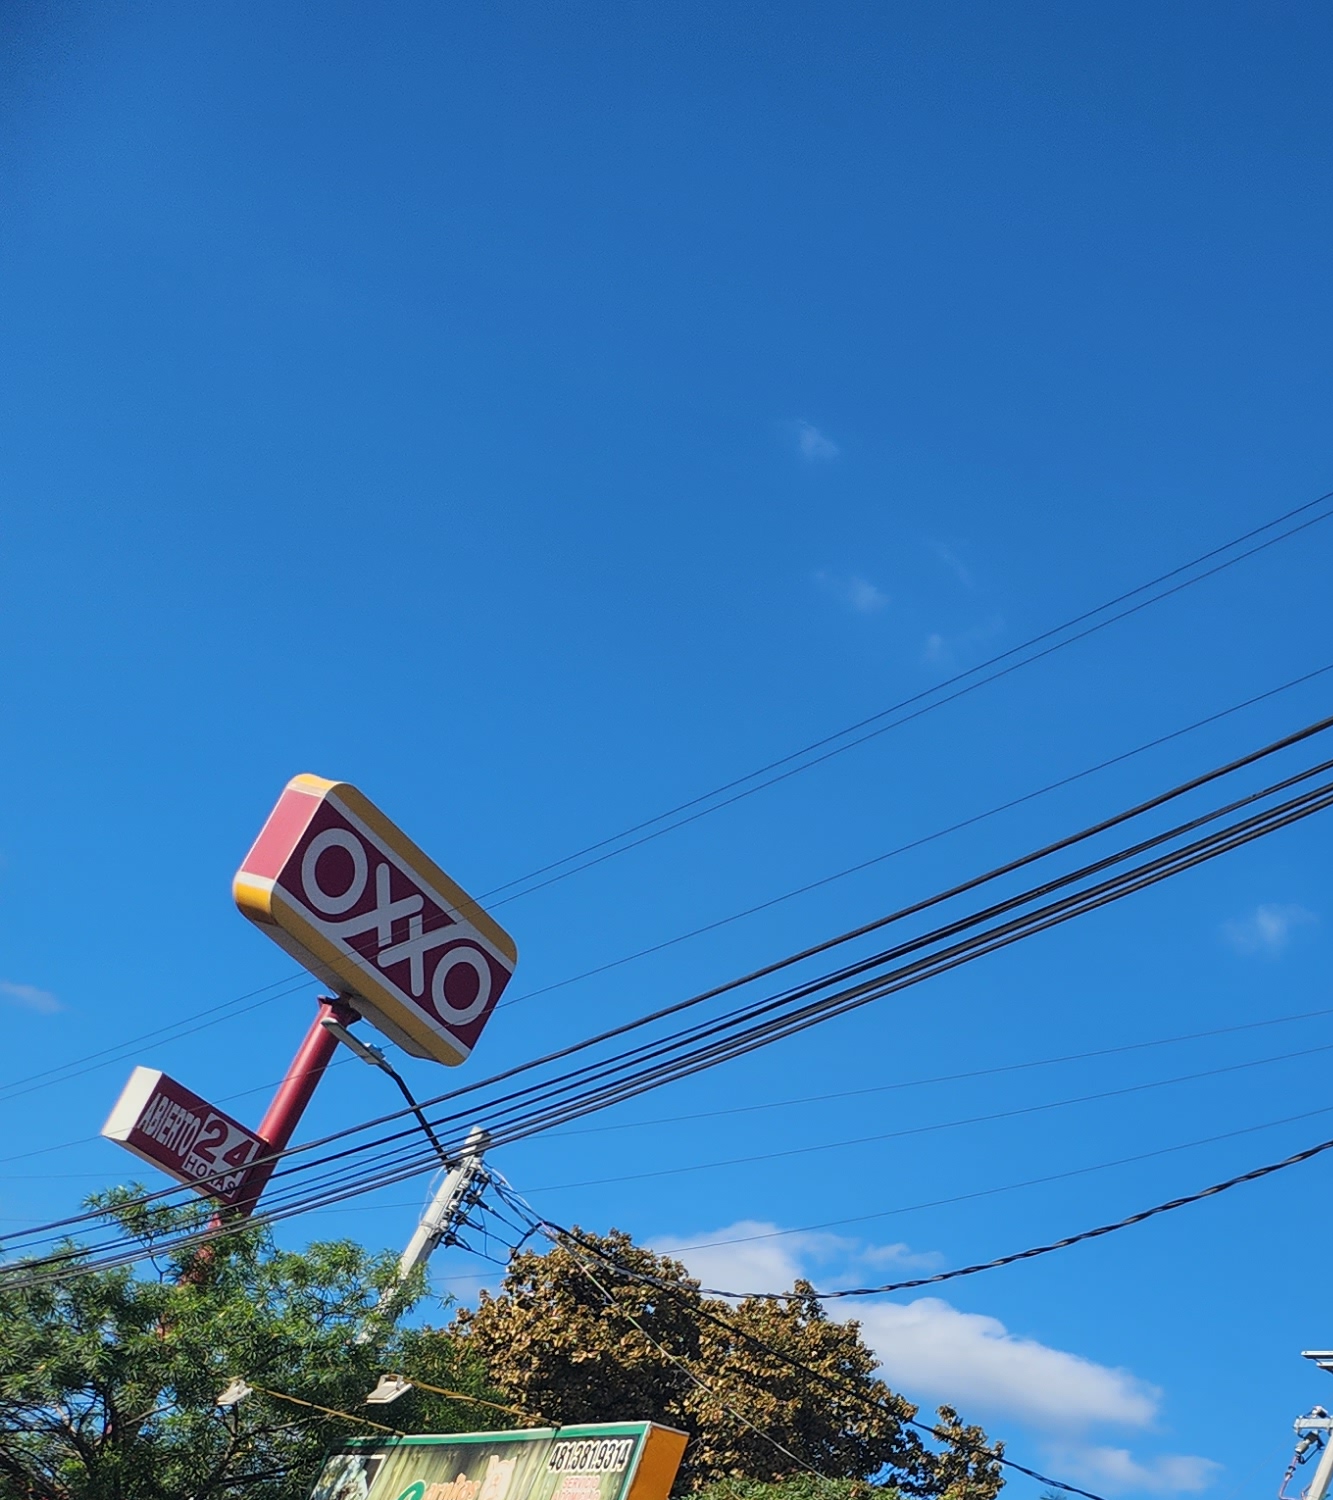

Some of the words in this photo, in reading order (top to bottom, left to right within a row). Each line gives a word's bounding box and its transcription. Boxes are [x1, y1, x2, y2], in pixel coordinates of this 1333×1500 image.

[302, 828, 492, 1026] OXXO
[137, 1092, 201, 1157] ABIERTO
[192, 1120, 255, 1180] 24
